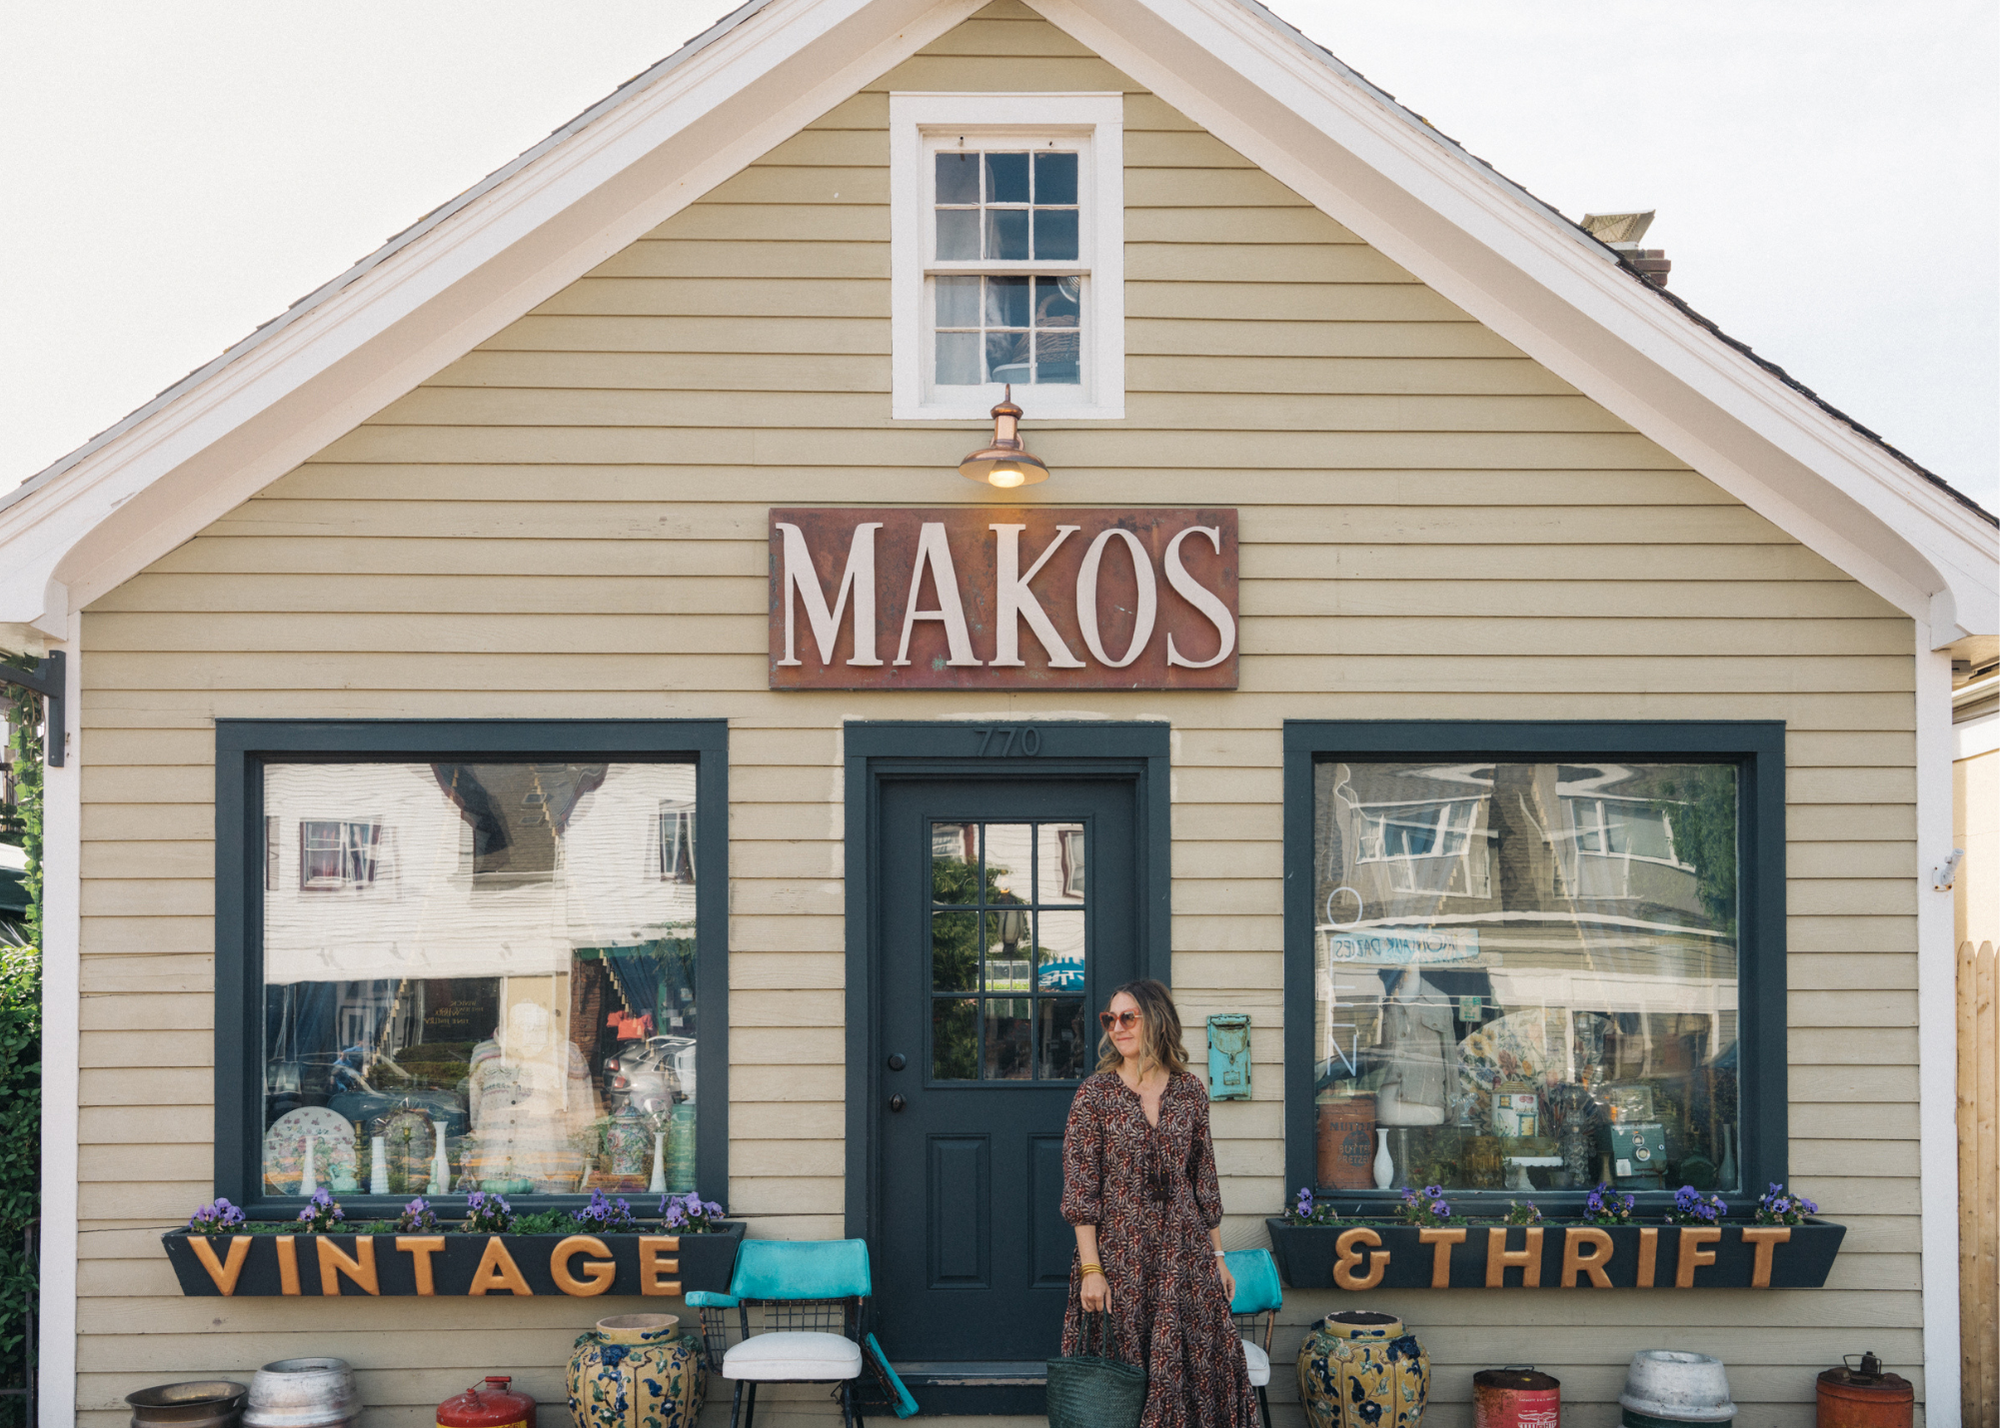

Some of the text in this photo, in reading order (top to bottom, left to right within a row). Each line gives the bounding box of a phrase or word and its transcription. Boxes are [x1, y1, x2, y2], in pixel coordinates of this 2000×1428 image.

[775, 522, 1236, 668] MAKOS
[973, 726, 1041, 757] 770
[1326, 886, 1363, 1077] OPEN
[187, 1235, 681, 1297] VINTAGE
[1332, 1227, 1791, 1291] & THRIFT
